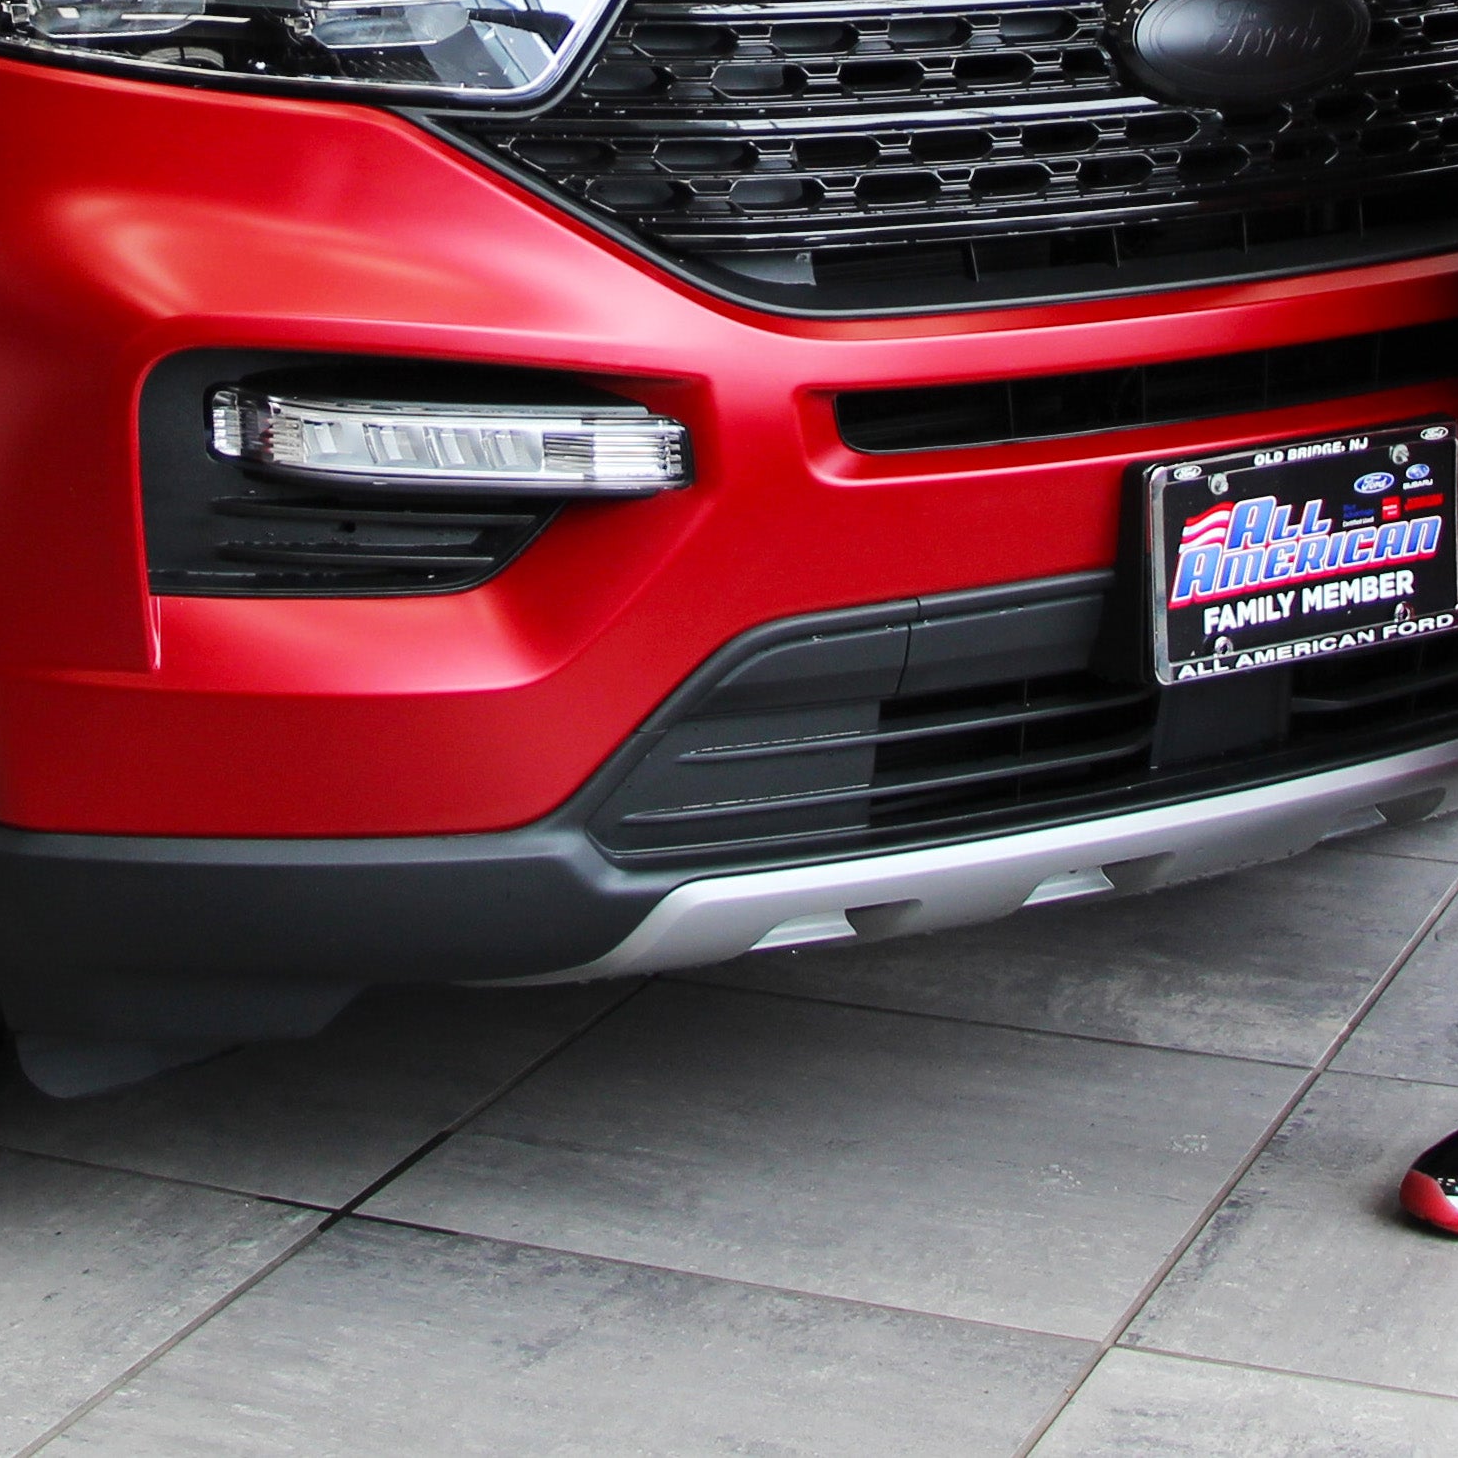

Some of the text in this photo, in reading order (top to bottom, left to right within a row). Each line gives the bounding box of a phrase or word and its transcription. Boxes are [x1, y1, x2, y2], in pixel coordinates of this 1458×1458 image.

[1253, 437, 1369, 467] OLD BRIDGE, NJ
[1359, 474, 1391, 492] Ford
[1225, 496, 1332, 552] ALL
[1170, 516, 1443, 604] AMERICAN
[1203, 569, 1415, 635] FAMILY MEMBER
[1177, 614, 1455, 681] ALL AMERICAN FORD
